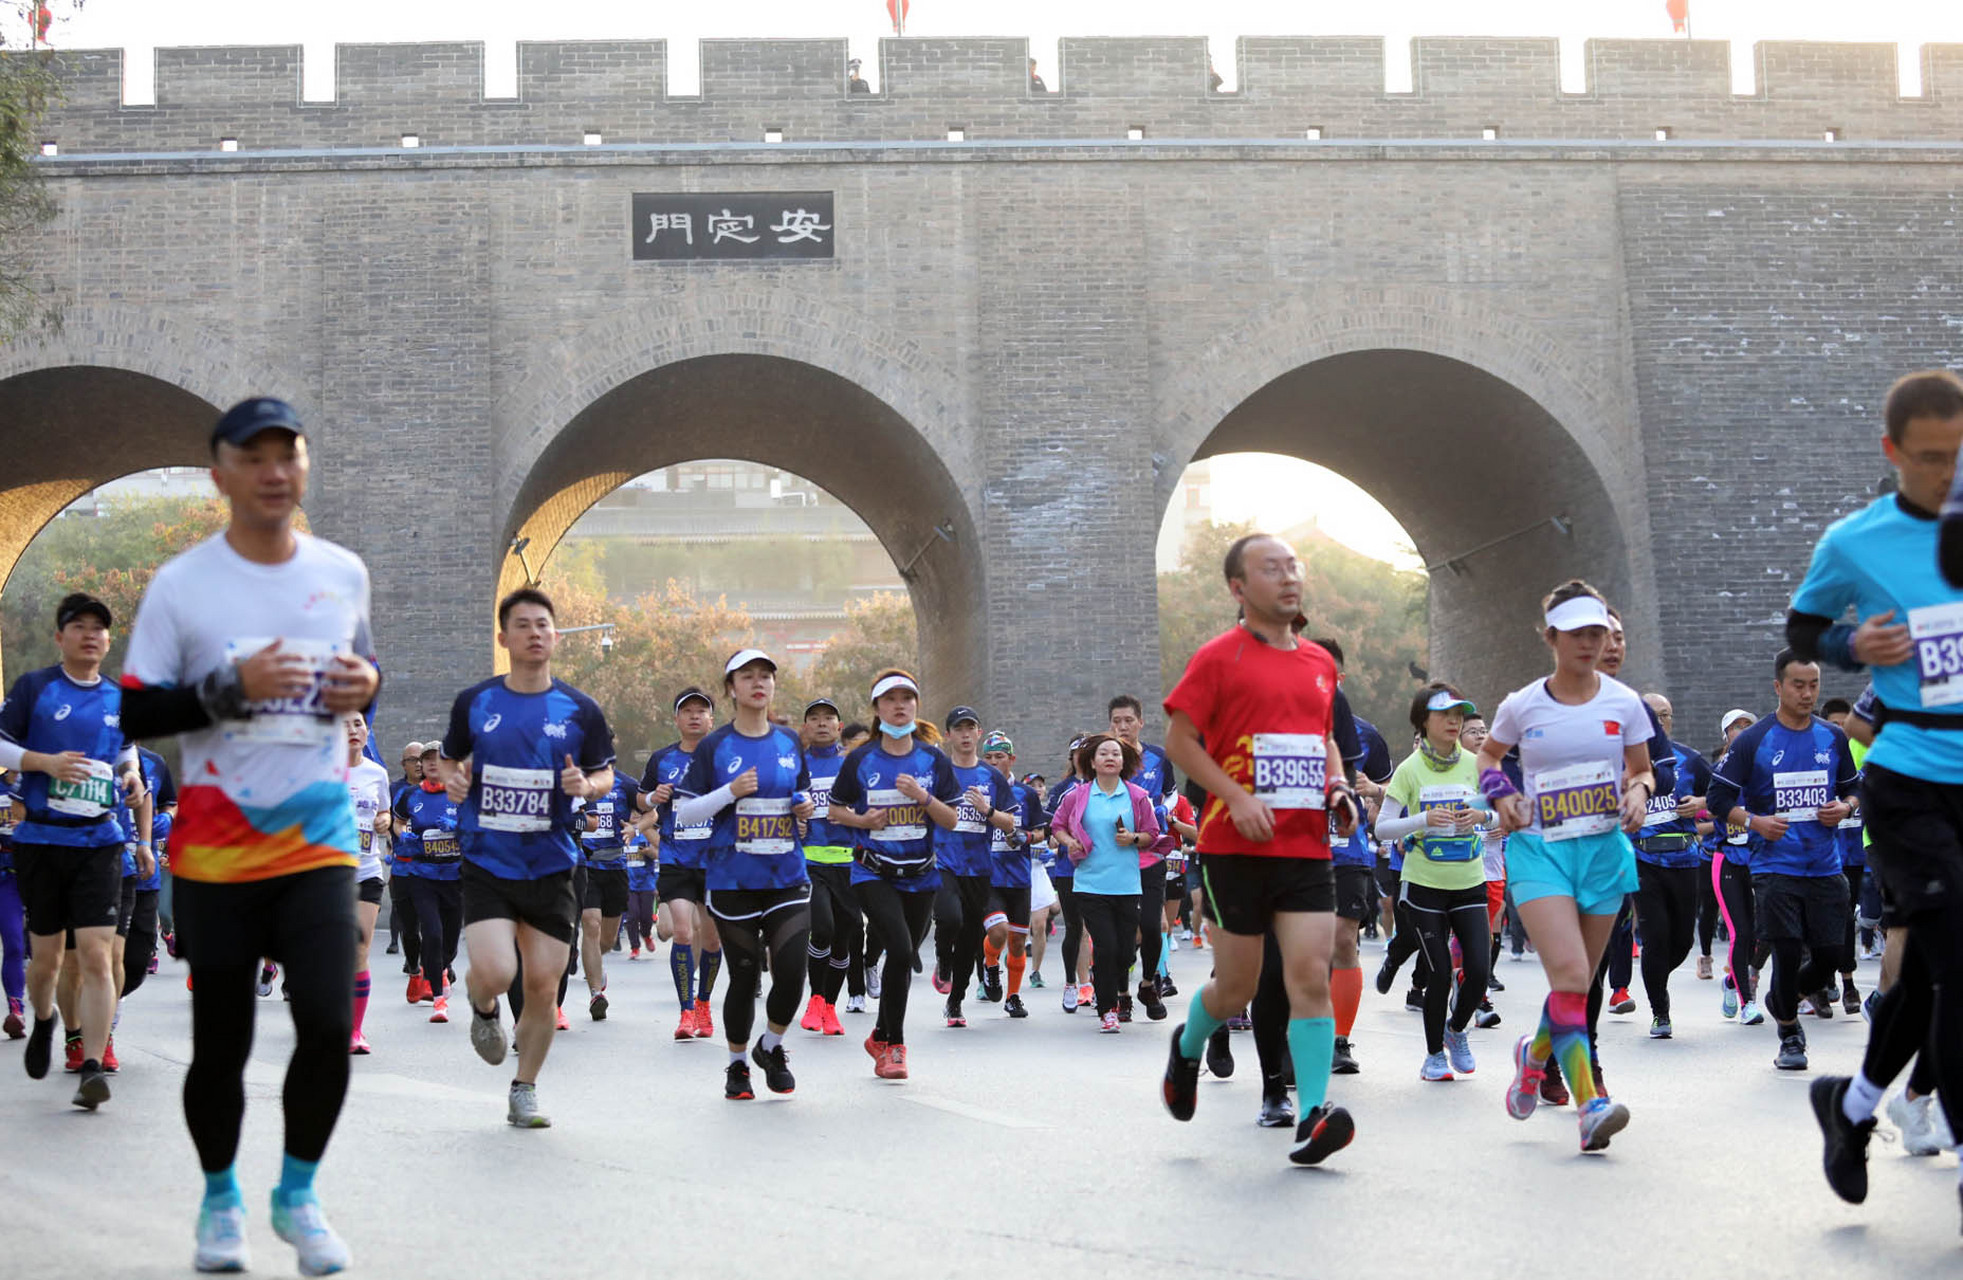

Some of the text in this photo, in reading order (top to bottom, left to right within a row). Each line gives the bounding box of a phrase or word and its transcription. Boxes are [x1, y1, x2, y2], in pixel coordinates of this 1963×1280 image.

[1919, 636, 1963, 678] B3
[1256, 758, 1325, 787] B39655
[482, 786, 550, 814] B33784
[1540, 785, 1618, 821] B40025
[1776, 787, 1827, 808] B33403
[738, 816, 793, 838] B41792
